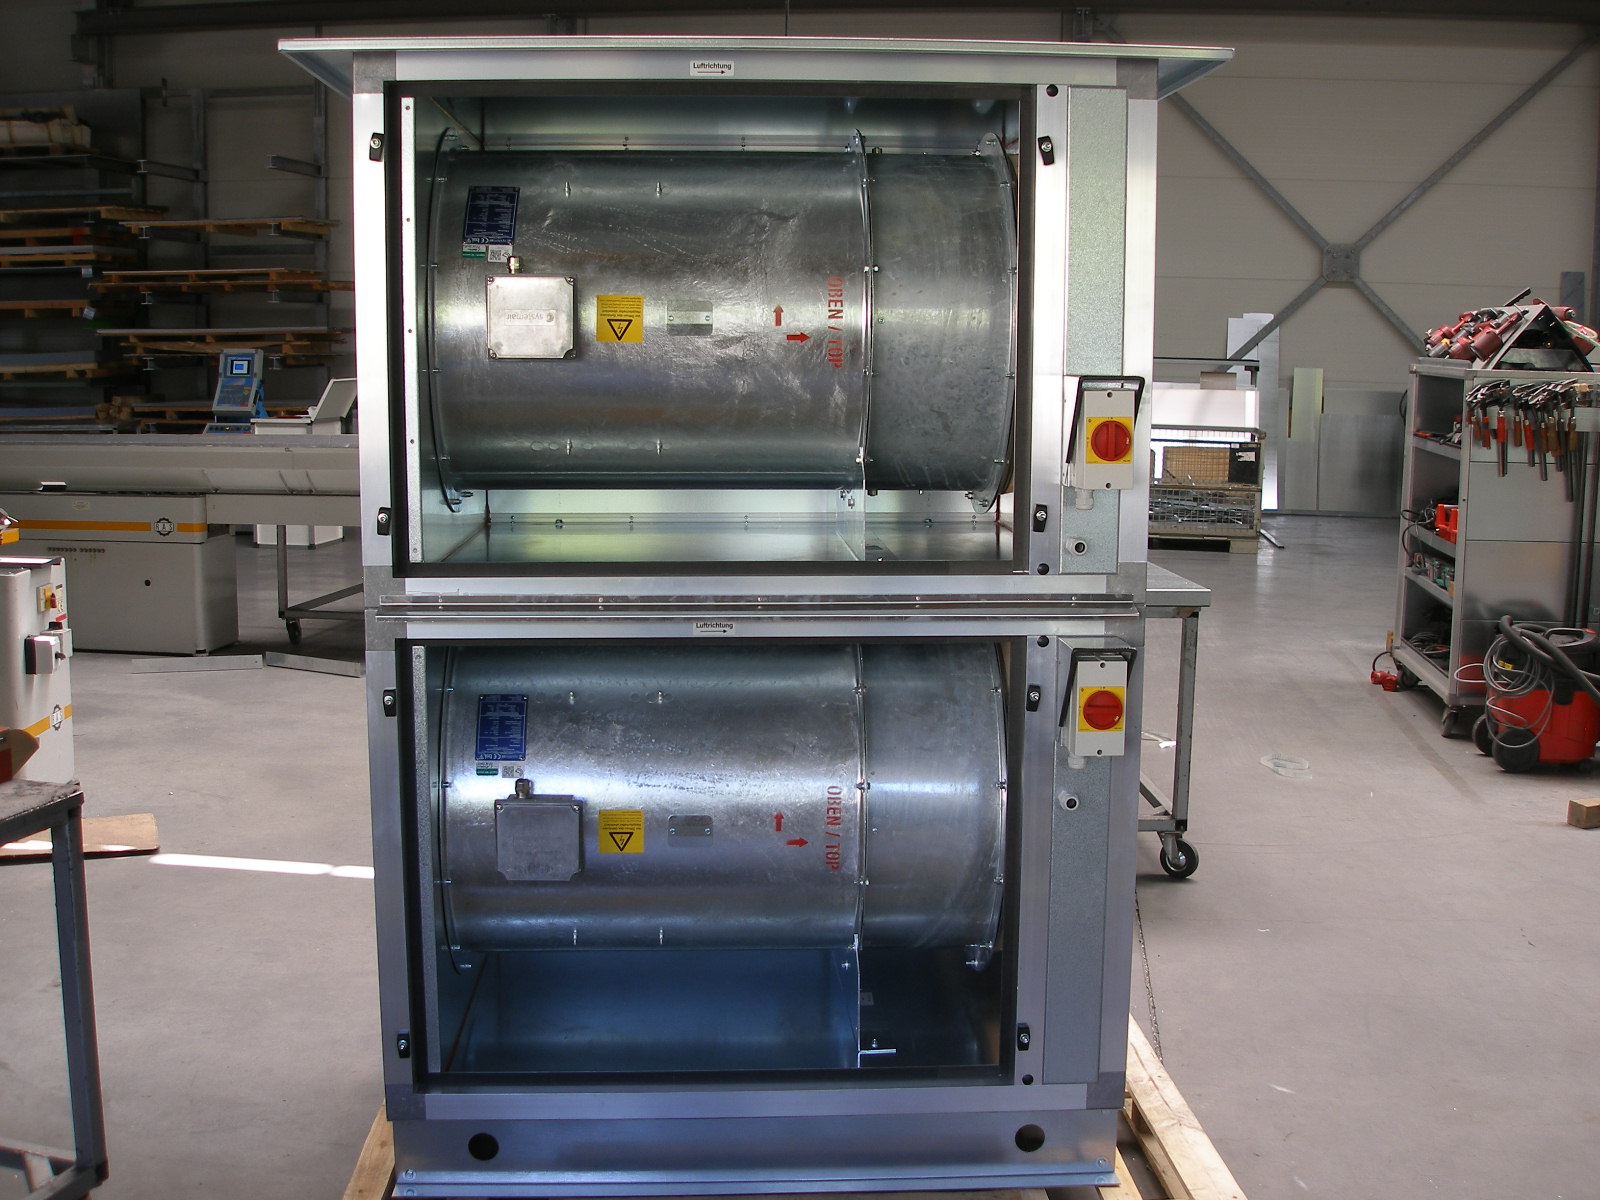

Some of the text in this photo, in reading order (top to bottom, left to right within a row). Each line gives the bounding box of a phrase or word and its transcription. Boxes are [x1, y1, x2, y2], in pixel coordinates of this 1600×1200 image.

[693, 62, 732, 70] Luftrichtung
[827, 276, 844, 320] OBEN
[506, 312, 544, 322] systemair
[827, 339, 844, 369] TOP
[695, 622, 734, 630] Luftrichtung
[826, 785, 843, 826] OBEN
[825, 842, 841, 871] TOP
